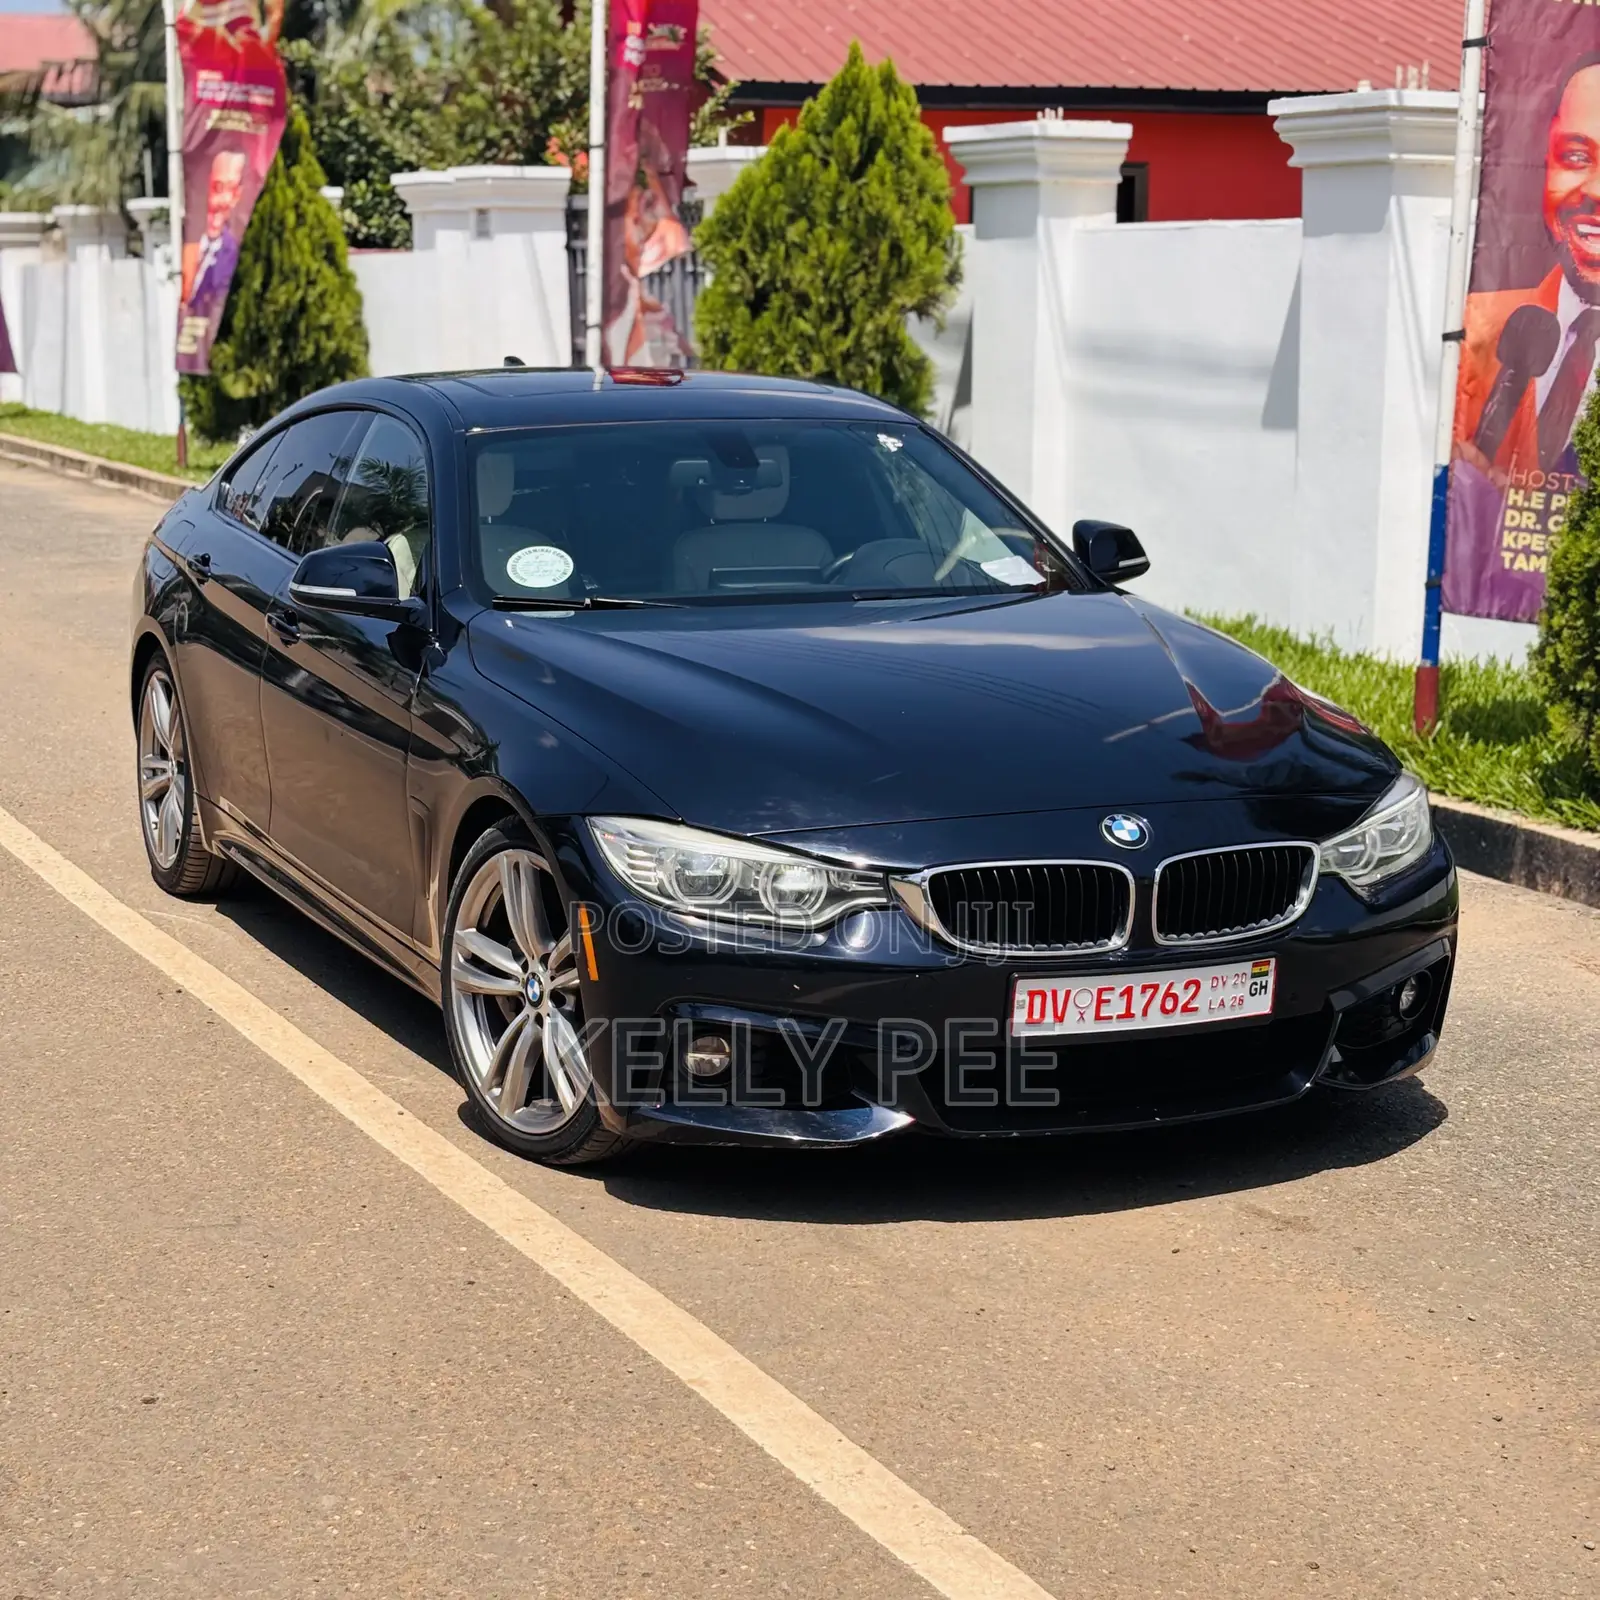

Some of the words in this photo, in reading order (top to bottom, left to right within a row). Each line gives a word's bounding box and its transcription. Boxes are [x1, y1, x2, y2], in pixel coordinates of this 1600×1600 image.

[1507, 488, 1546, 510] H.E
[1550, 494, 1570, 511] P
[1504, 509, 1542, 530] DR.
[1547, 515, 1567, 532] C
[1501, 551, 1549, 573] TAM
[1211, 975, 1228, 989] DV
[1232, 972, 1247, 986] 20
[1249, 979, 1268, 997] GH
[1025, 989, 1071, 1025] DV
[1094, 978, 1202, 1022] E1762
[1208, 996, 1226, 1010] LA
